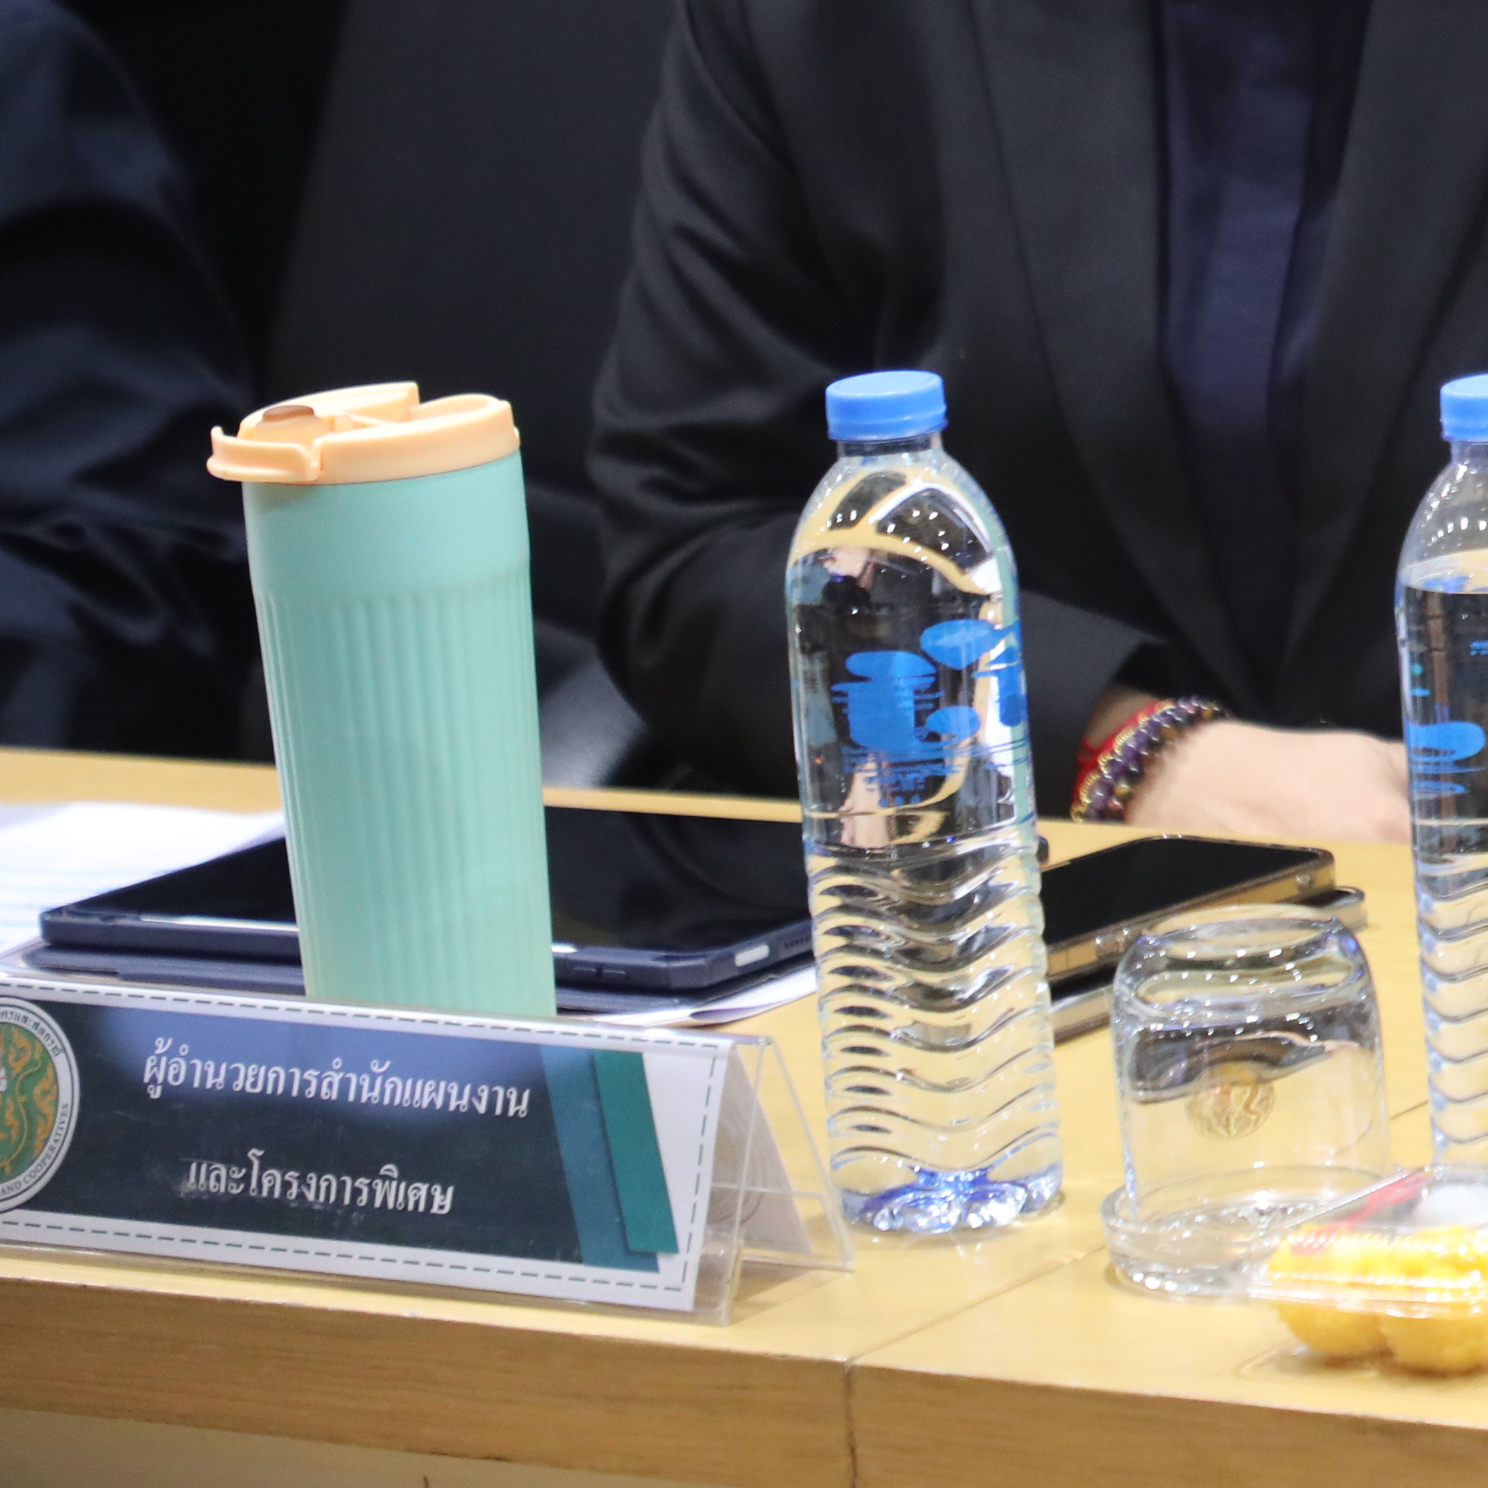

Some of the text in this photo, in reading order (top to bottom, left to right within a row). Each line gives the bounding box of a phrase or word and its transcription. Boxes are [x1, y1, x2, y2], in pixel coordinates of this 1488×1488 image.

[143, 1037, 531, 1118] ผู้อำนวยการสำนักแผนงาน
[23, 1103, 68, 1184] COOPERATIVES
[188, 1148, 455, 1214] และโครงการพิเศษ
